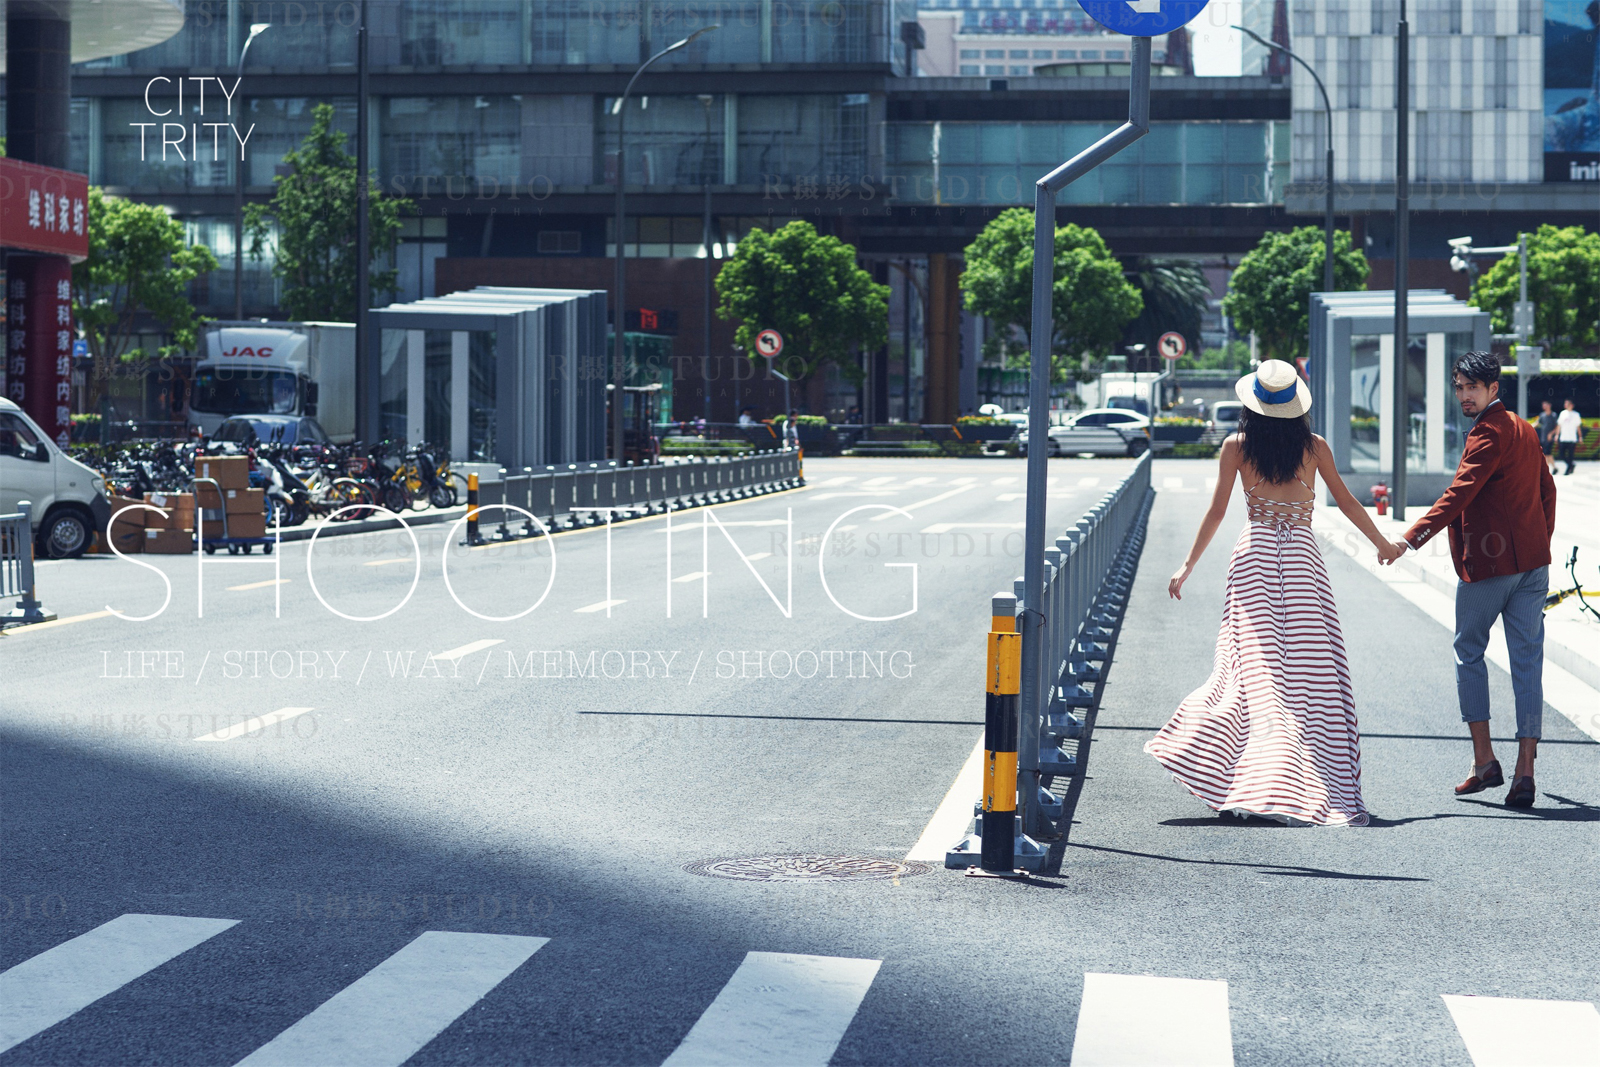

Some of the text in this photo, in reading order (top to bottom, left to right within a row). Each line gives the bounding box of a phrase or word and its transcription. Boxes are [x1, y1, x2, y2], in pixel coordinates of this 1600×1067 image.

[28, 188, 88, 237] 维科家纺
[10, 279, 26, 410] 维科家纺内
[223, 346, 273, 358] JAC
